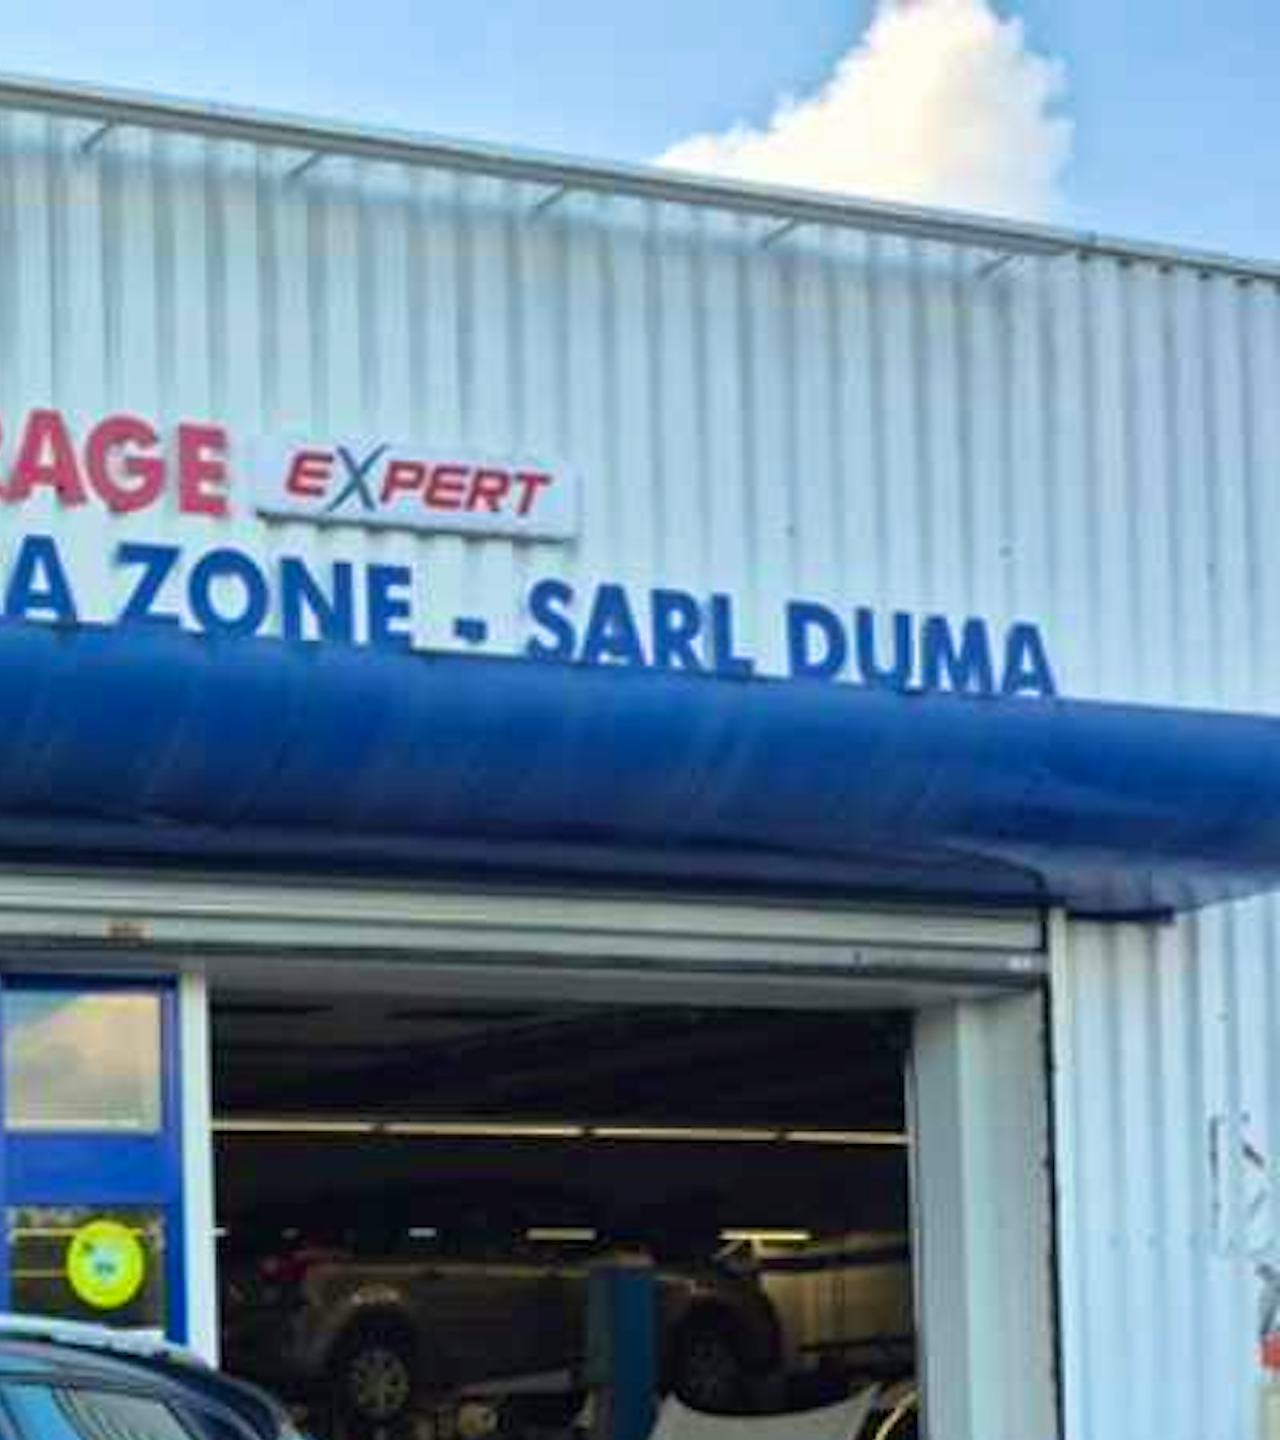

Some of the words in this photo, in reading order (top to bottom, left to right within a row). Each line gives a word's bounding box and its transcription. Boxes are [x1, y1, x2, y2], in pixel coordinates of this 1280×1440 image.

[114, 541, 412, 644] ZONE
[453, 616, 488, 643] -
[526, 578, 755, 682] SARL
[785, 599, 1056, 697] DUMA
